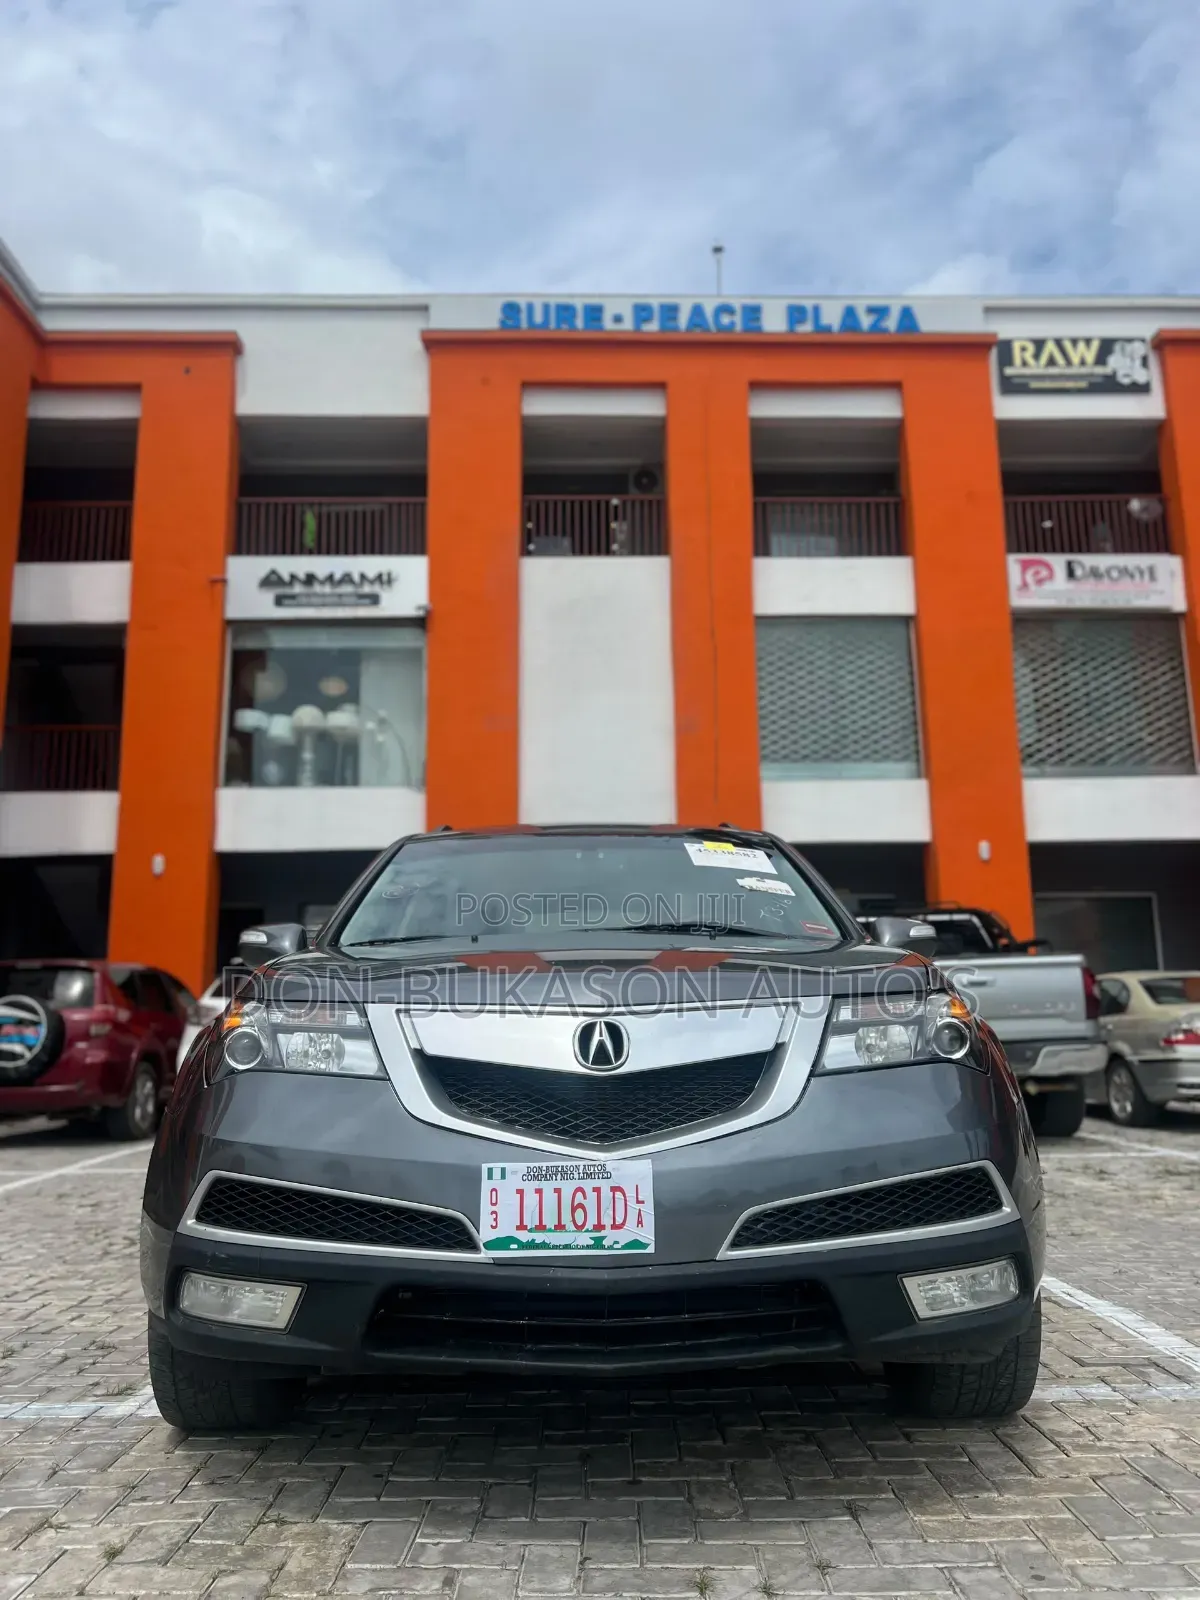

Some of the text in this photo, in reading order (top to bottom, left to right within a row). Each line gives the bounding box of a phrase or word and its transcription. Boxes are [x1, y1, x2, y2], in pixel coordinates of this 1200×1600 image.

[786, 303, 921, 333] PLAZA
[1011, 339, 1101, 368] RAW
[521, 1172, 560, 1182] COMPANY
[578, 1170, 612, 1181] LIMITED
[526, 1164, 608, 1174] DON-BUKASON AUTOS
[515, 1185, 628, 1232] 11161D
